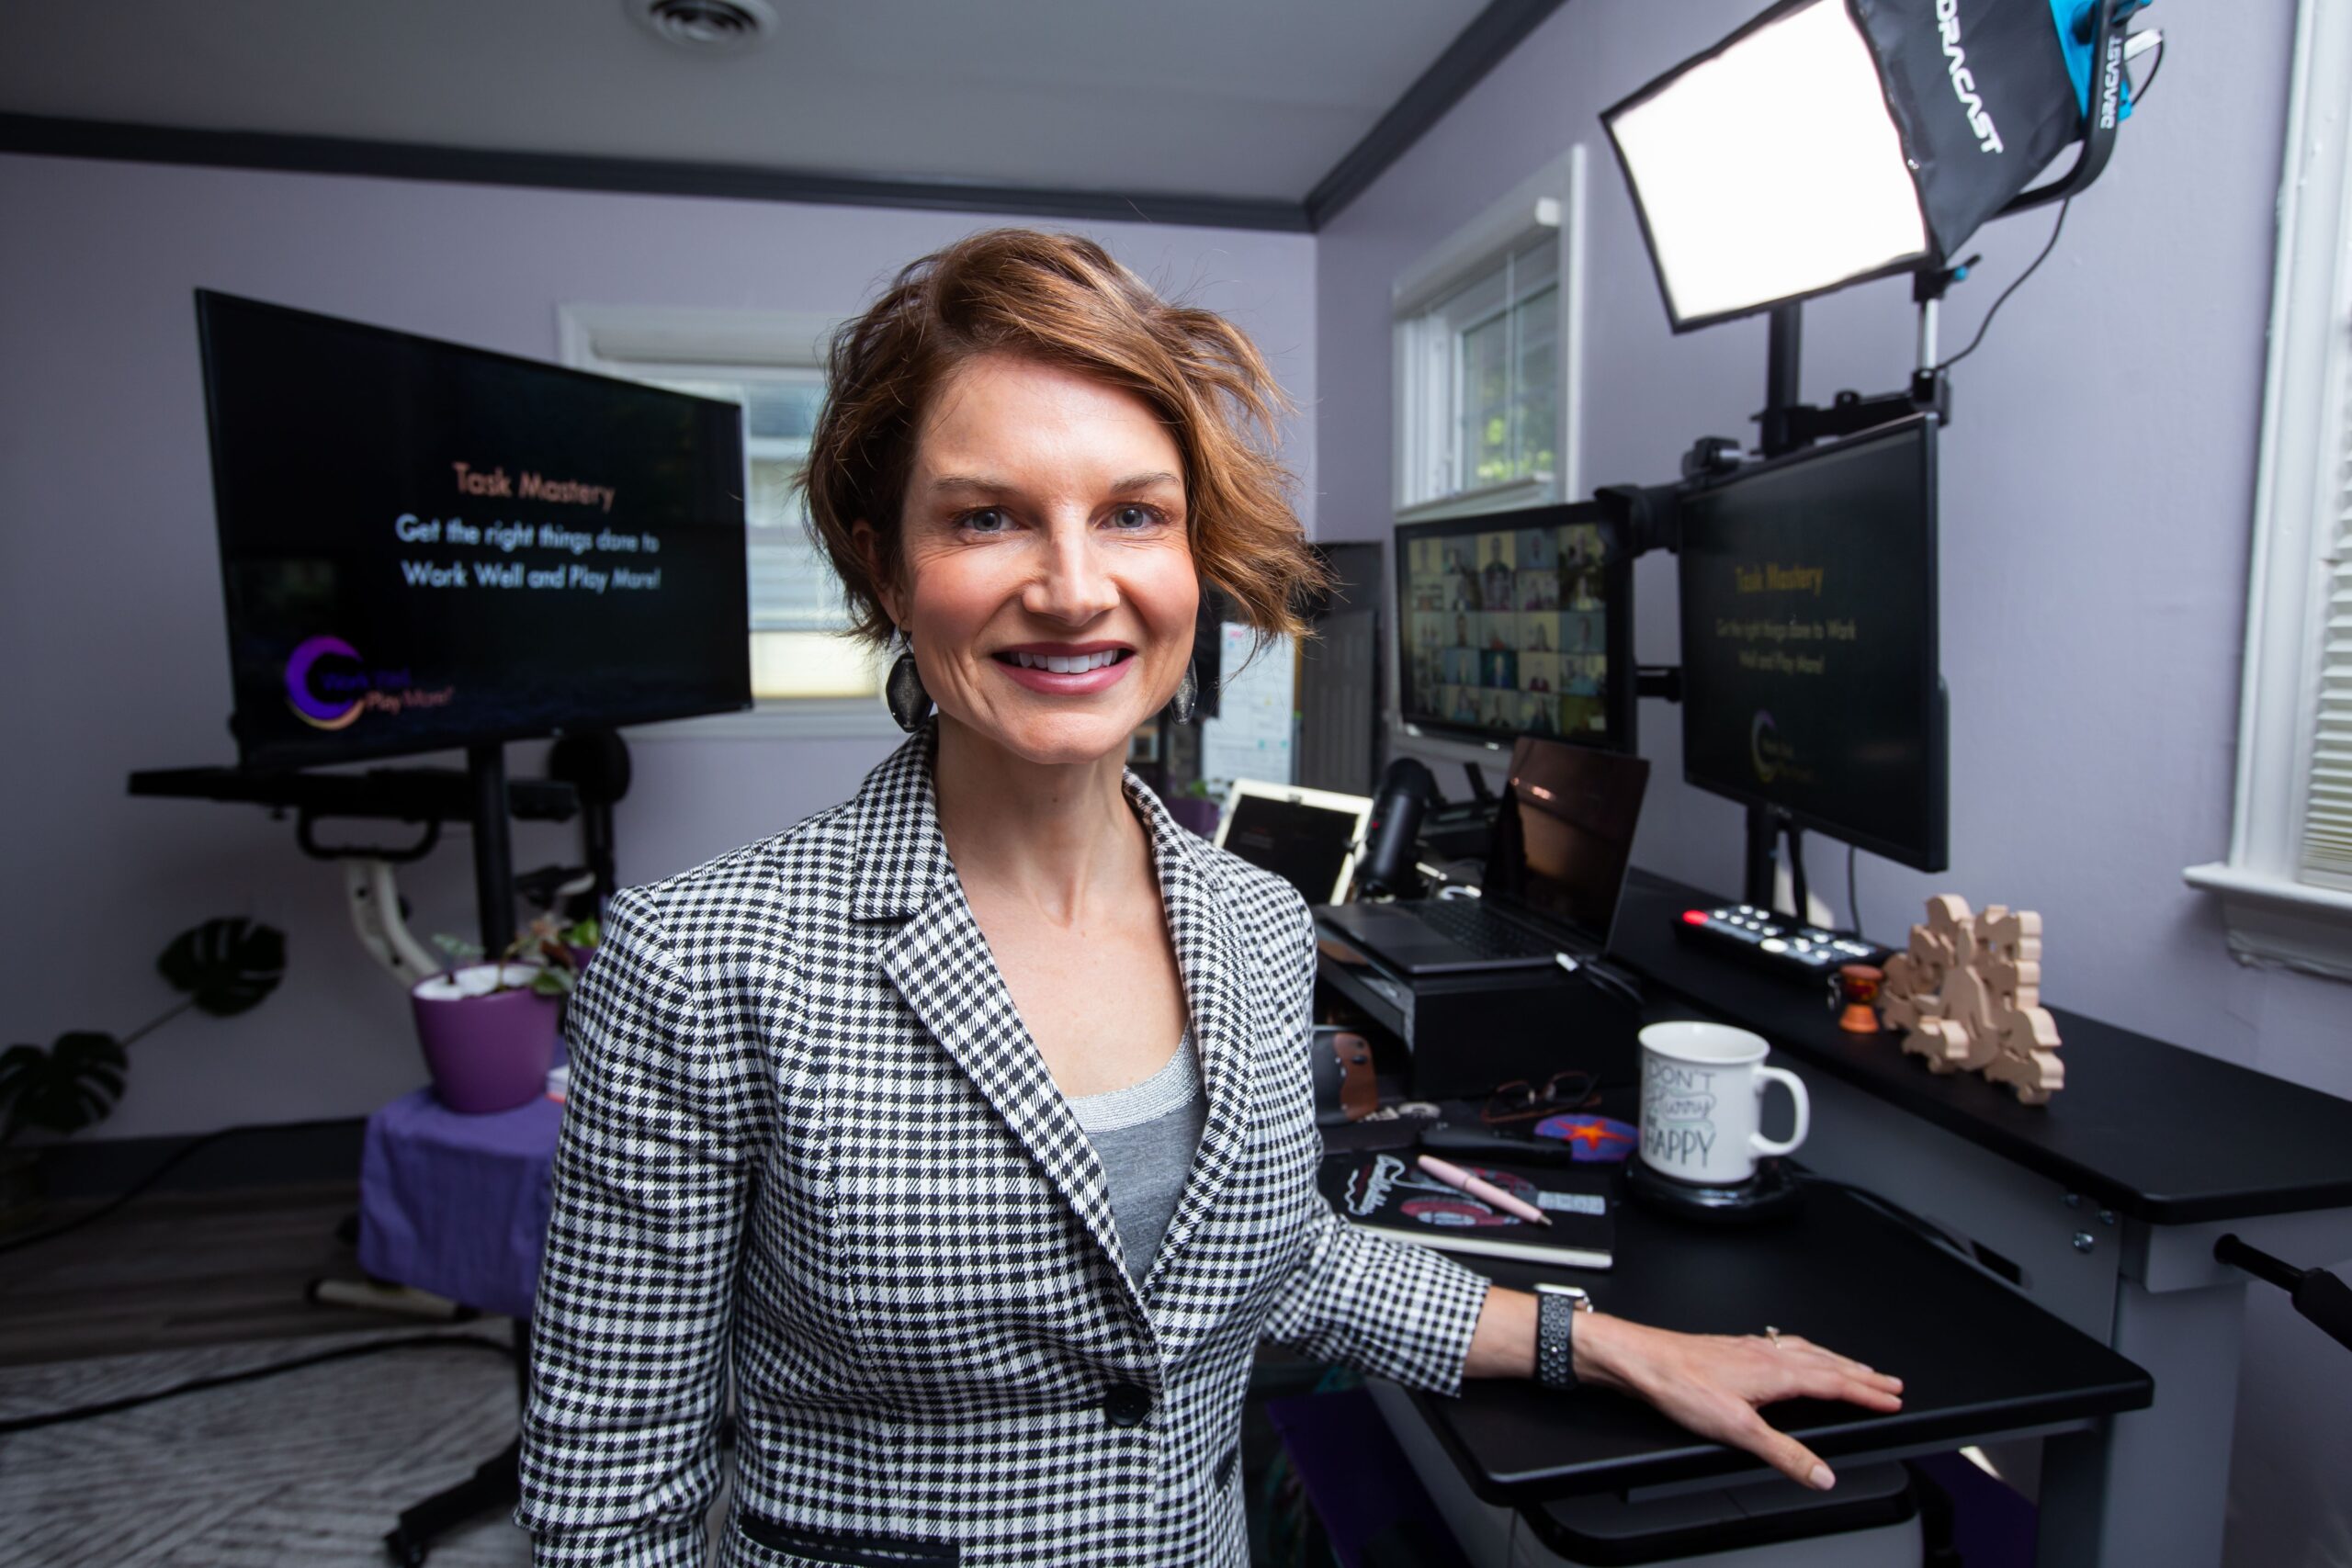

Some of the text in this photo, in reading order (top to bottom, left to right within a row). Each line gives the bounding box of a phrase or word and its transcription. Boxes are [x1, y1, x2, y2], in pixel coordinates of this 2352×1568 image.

[1936, 0, 2004, 153] DRACAST
[2100, 35, 2121, 130] DRACAST
[452, 460, 615, 513] Task Mastery
[395, 513, 660, 556] Get the right things done to
[401, 558, 662, 595] Work Well and Play More!
[1736, 562, 1824, 597] Task Mastery
[1645, 1128, 1717, 1168] HAPPY
